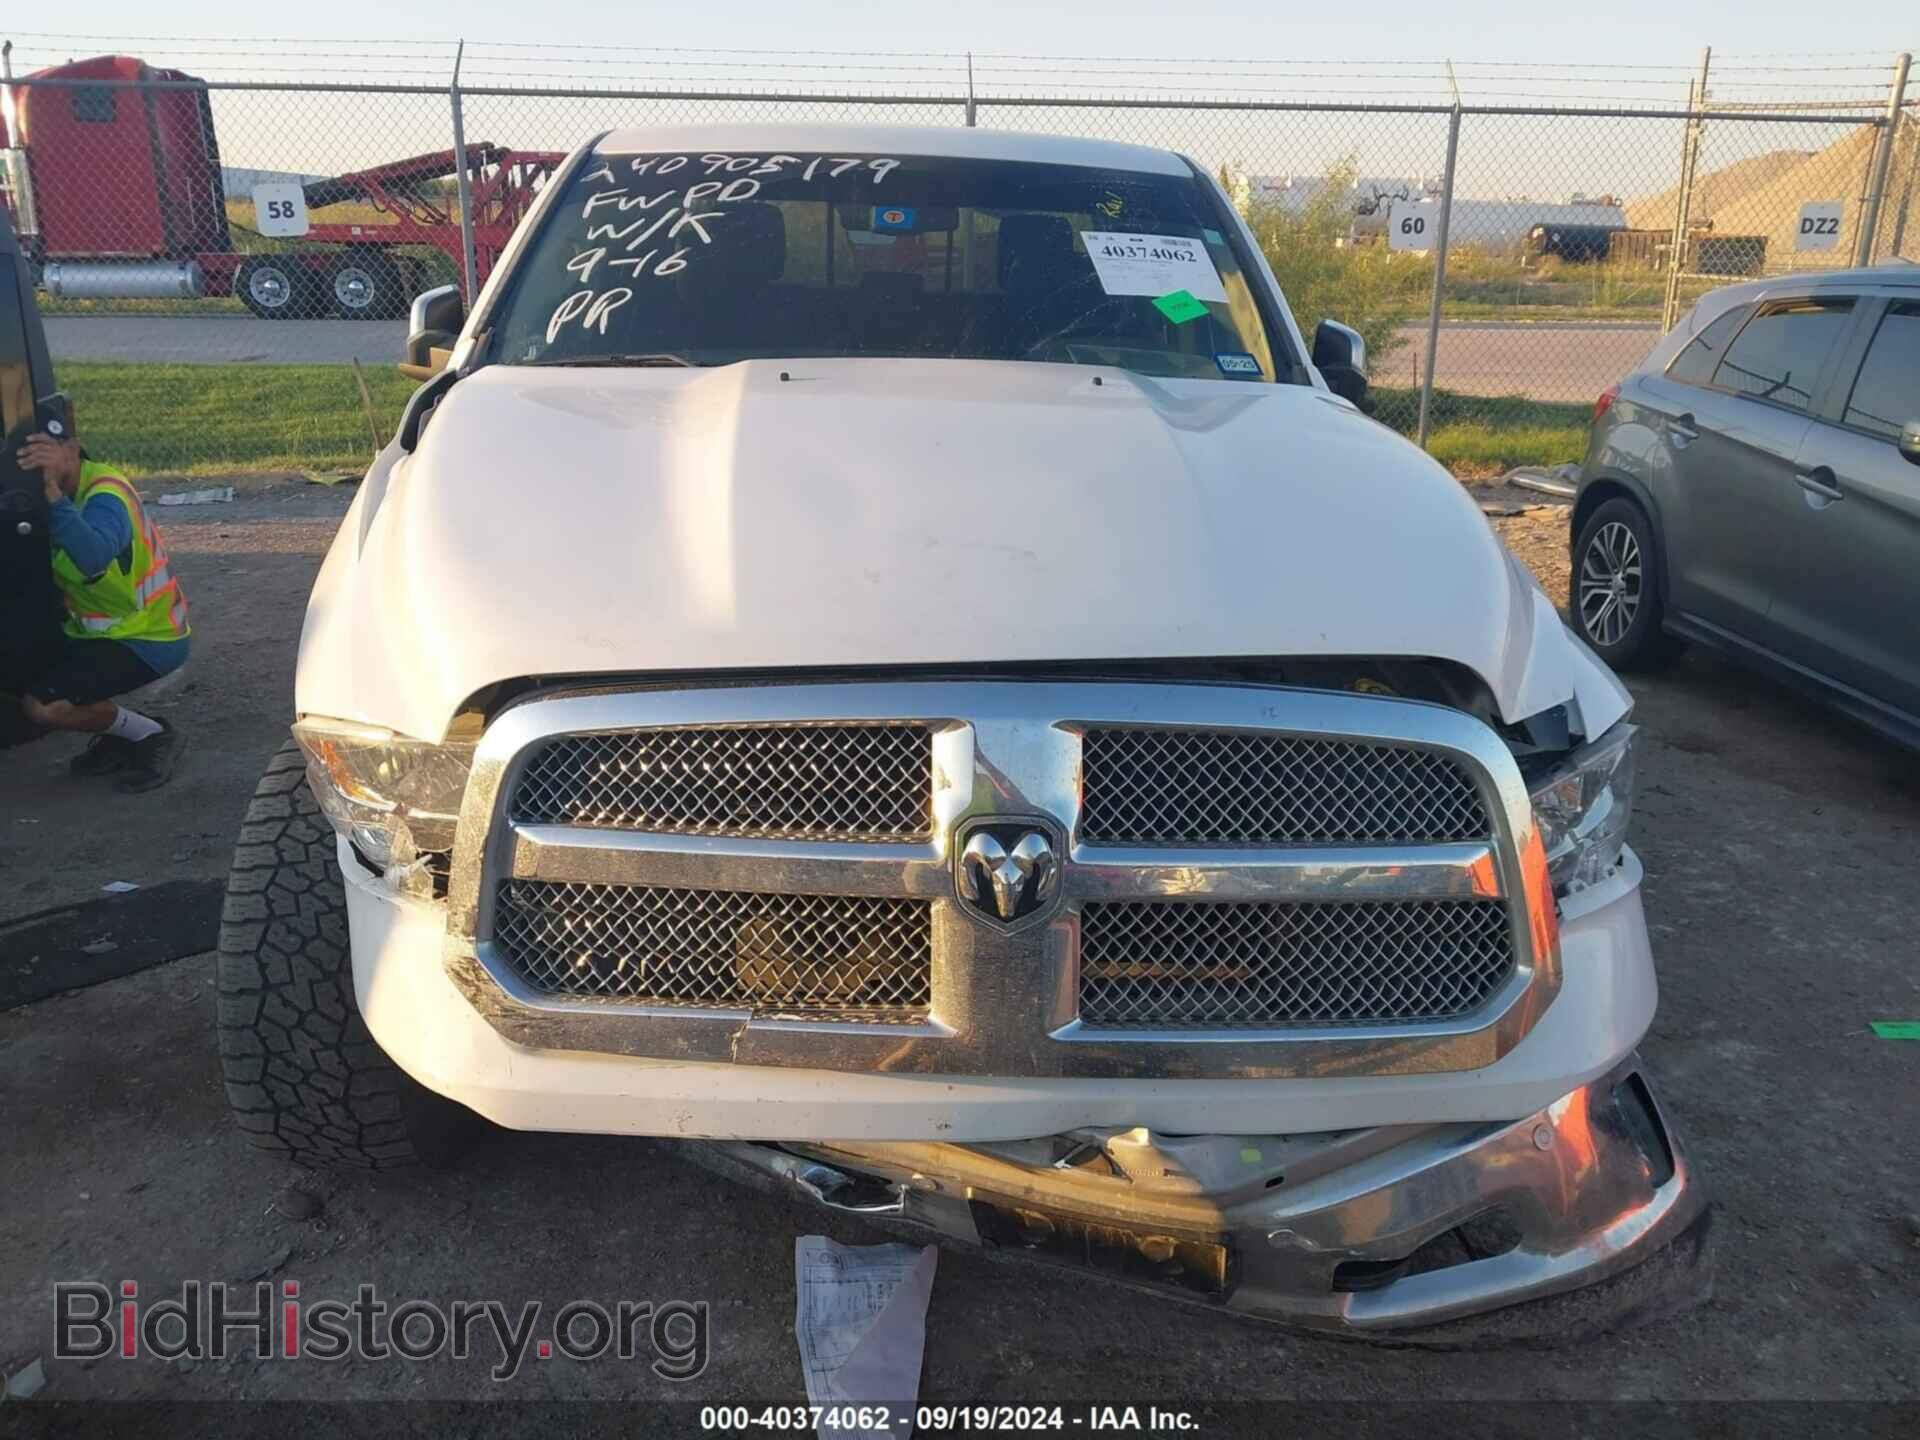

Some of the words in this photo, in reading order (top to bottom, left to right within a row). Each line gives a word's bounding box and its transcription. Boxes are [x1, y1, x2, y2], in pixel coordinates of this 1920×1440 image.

[267, 200, 296, 219] 58
[1401, 217, 1425, 234] 60
[1800, 217, 1839, 234] DZ2
[1101, 244, 1198, 263] 40374062
[567, 247, 691, 282] 9-16
